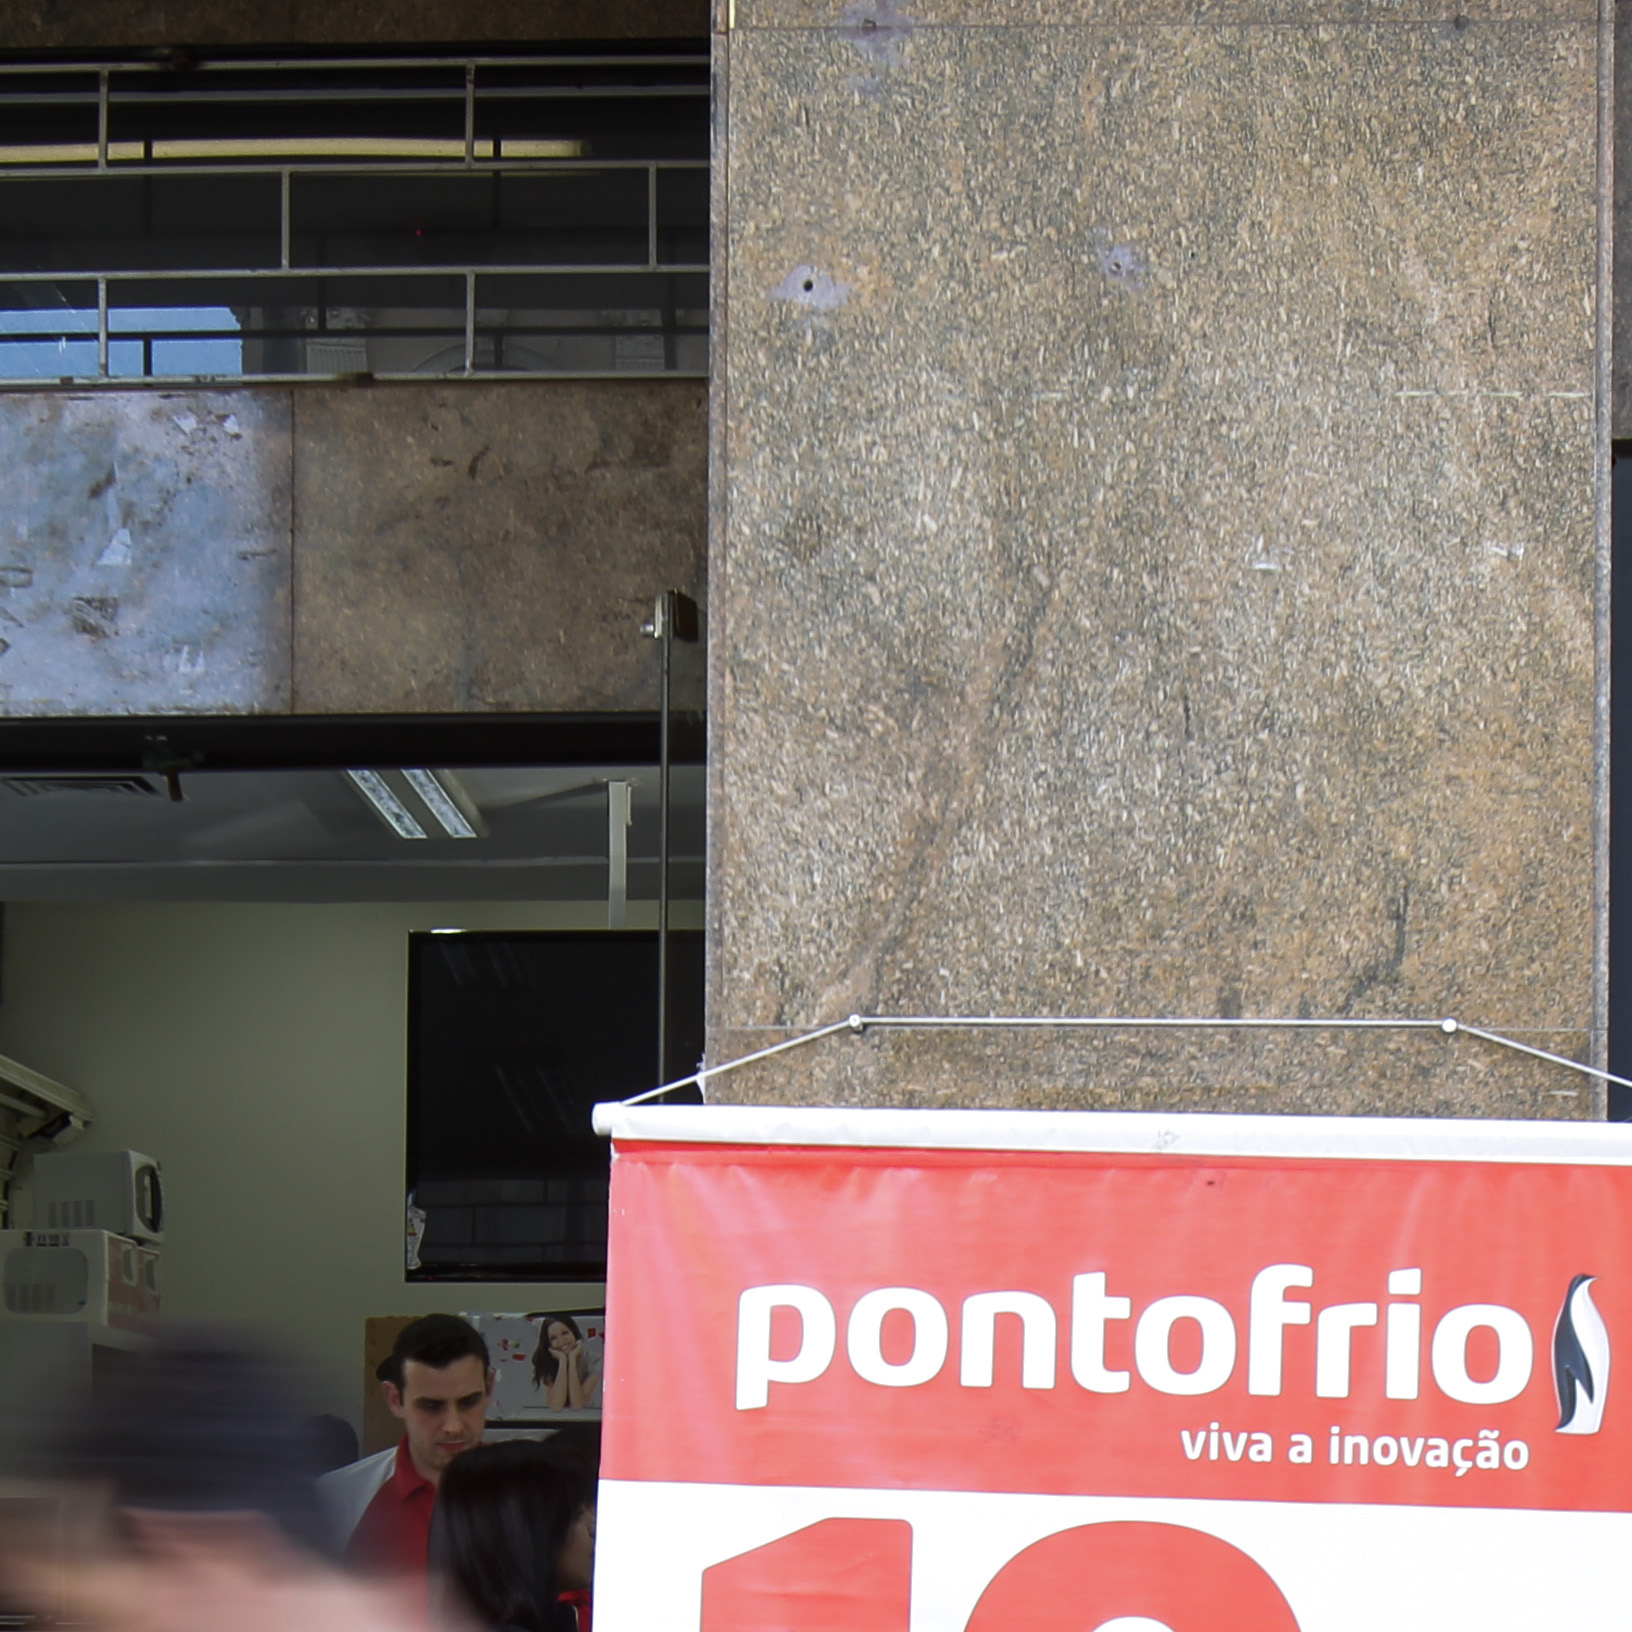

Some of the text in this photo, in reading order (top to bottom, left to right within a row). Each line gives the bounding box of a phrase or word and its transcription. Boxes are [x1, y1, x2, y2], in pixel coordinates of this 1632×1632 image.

[735, 1264, 1534, 1411] pontofrio
[1182, 1421, 1529, 1477] viva a inovação
